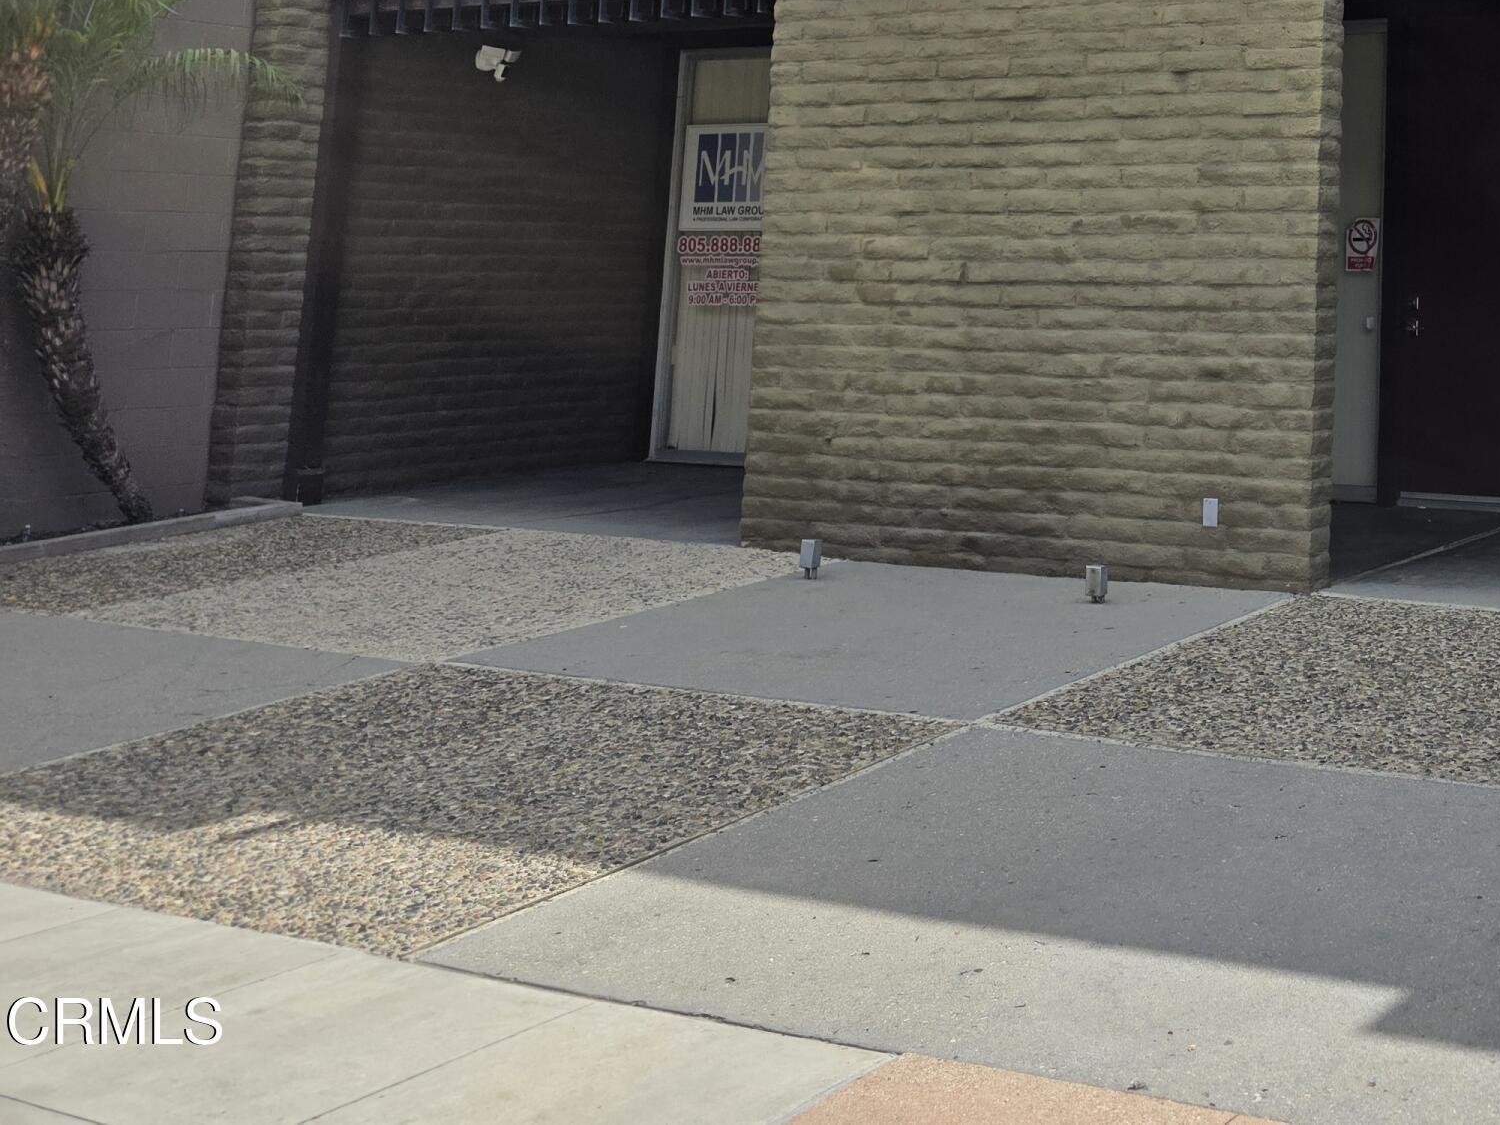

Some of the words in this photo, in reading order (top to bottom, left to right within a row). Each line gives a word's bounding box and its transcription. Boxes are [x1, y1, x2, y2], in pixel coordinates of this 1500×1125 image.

[693, 205, 714, 216] MHM
[715, 205, 737, 216] LAW
[737, 205, 764, 216] GROU
[679, 237, 760, 253] 805.888.88
[681, 256, 759, 266] www.mhmlawgroup.
[706, 270, 748, 279] ABIERTO:
[688, 282, 716, 291] LUNES
[718, 282, 724, 291] A
[726, 282, 759, 291] VIERNE
[688, 295, 706, 304] 9:00
[708, 295, 722, 304] AM
[729, 295, 747, 304] 6:00
